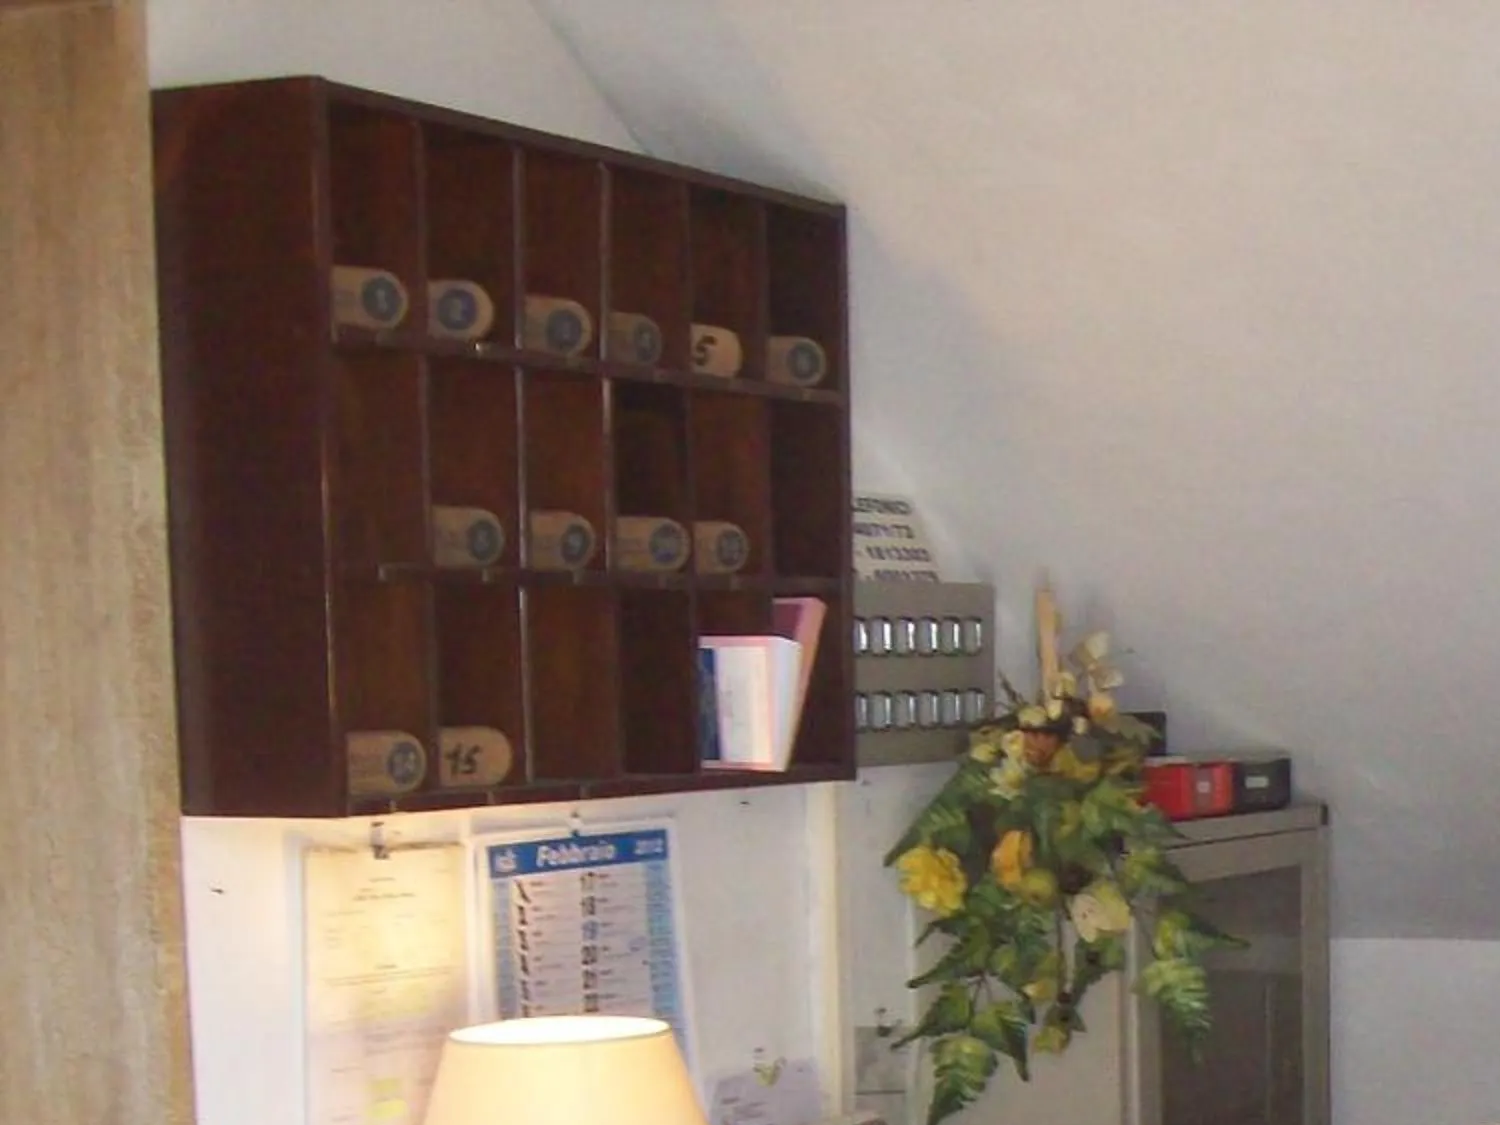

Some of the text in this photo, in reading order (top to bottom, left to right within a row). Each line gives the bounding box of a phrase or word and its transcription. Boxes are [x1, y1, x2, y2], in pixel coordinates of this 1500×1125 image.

[694, 334, 719, 368] 5
[446, 742, 485, 780] 15
[535, 839, 617, 868] Febbraio
